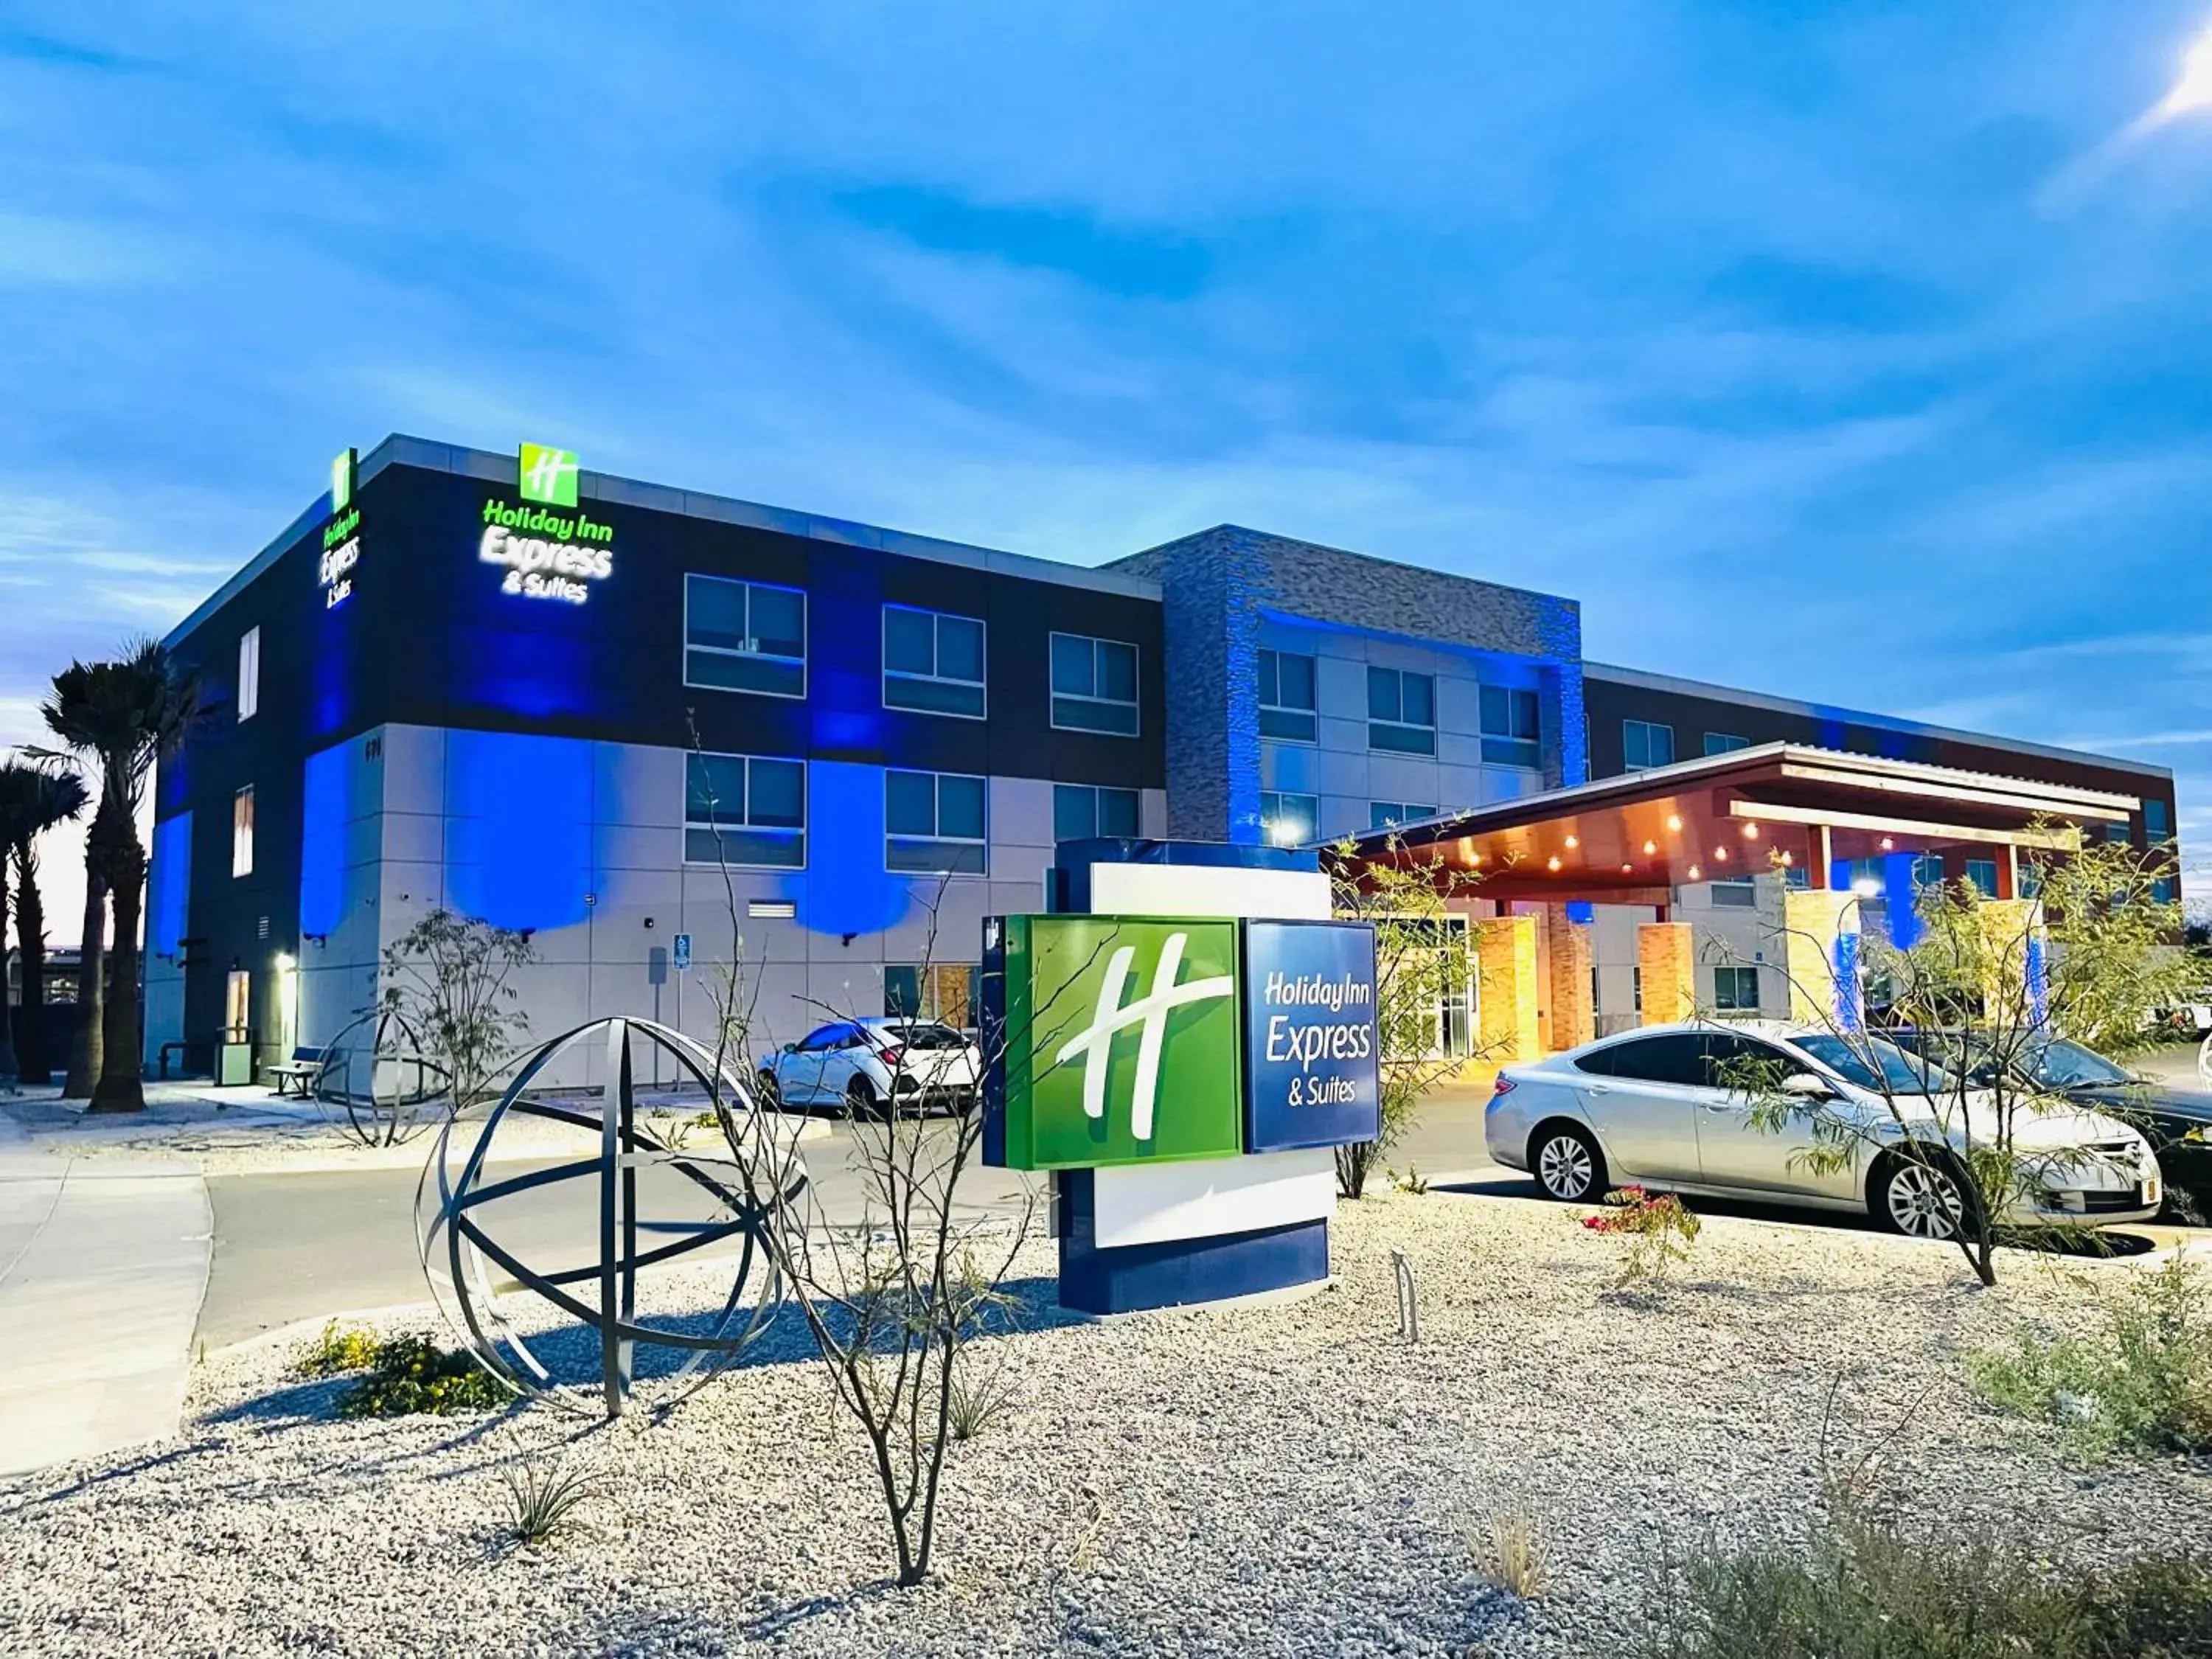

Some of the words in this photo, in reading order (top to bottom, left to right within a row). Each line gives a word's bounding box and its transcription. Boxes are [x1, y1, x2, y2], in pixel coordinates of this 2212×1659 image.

[483, 499, 574, 540] Holiday
[577, 515, 613, 542] Inn
[480, 524, 613, 579] Express
[501, 570, 521, 594] &
[524, 573, 588, 604] Suites
[1264, 971, 1343, 1012] Holiday
[1345, 973, 1369, 1005] Inn
[1266, 1015, 1371, 1074] Express
[1288, 1077, 1303, 1107] &
[1307, 1077, 1355, 1105] Suites
